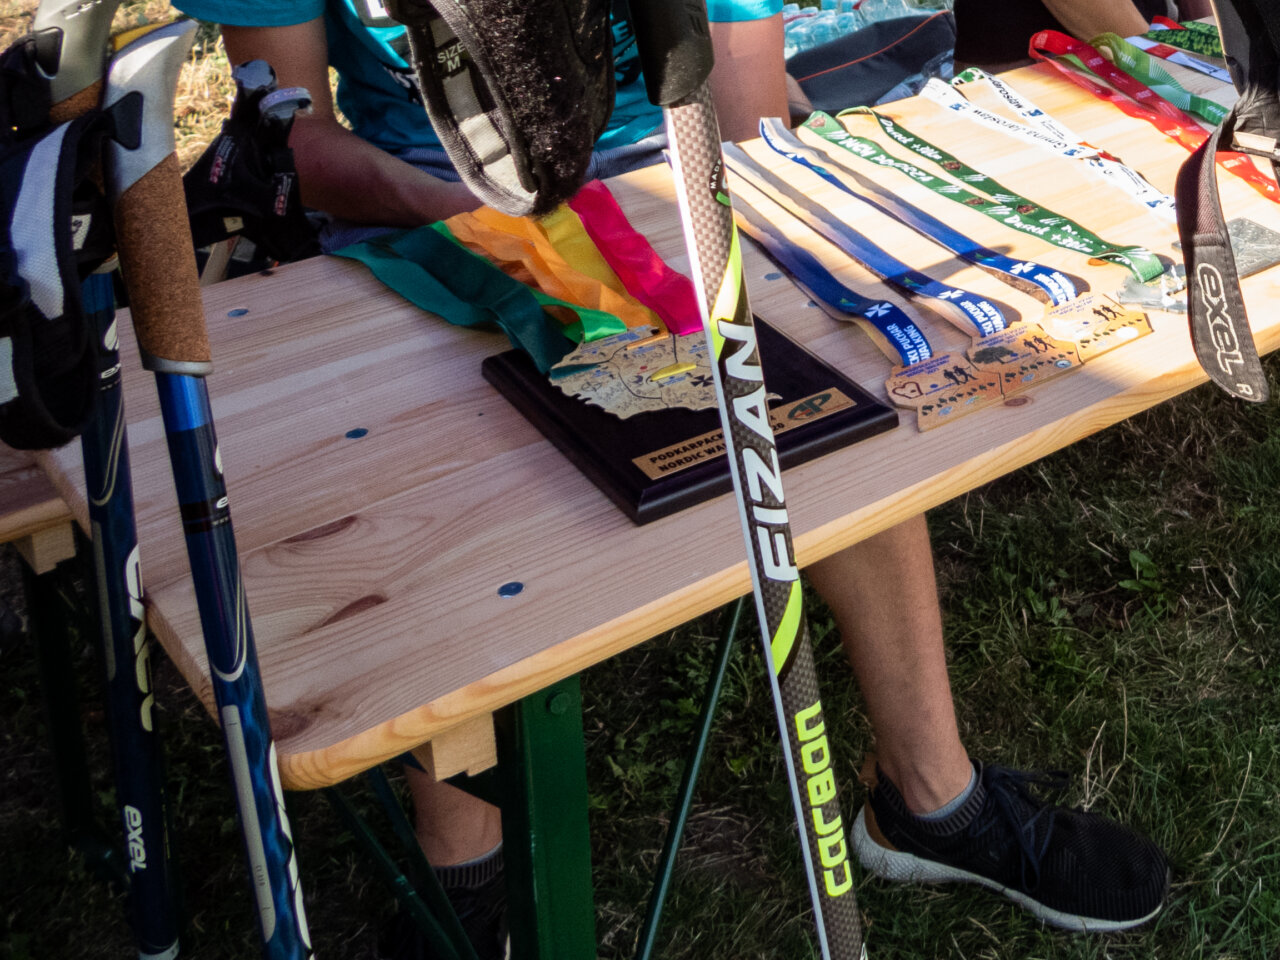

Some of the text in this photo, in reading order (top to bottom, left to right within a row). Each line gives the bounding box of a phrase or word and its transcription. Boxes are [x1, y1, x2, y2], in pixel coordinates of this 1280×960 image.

[437, 41, 466, 64] SIZE
[446, 56, 462, 73] M
[886, 323, 913, 350] PUCHAR
[1236, 383, 1254, 397] R
[649, 433, 726, 464] PODKARPACK
[717, 319, 799, 583] FIZAN
[658, 451, 703, 473] NORDIC
